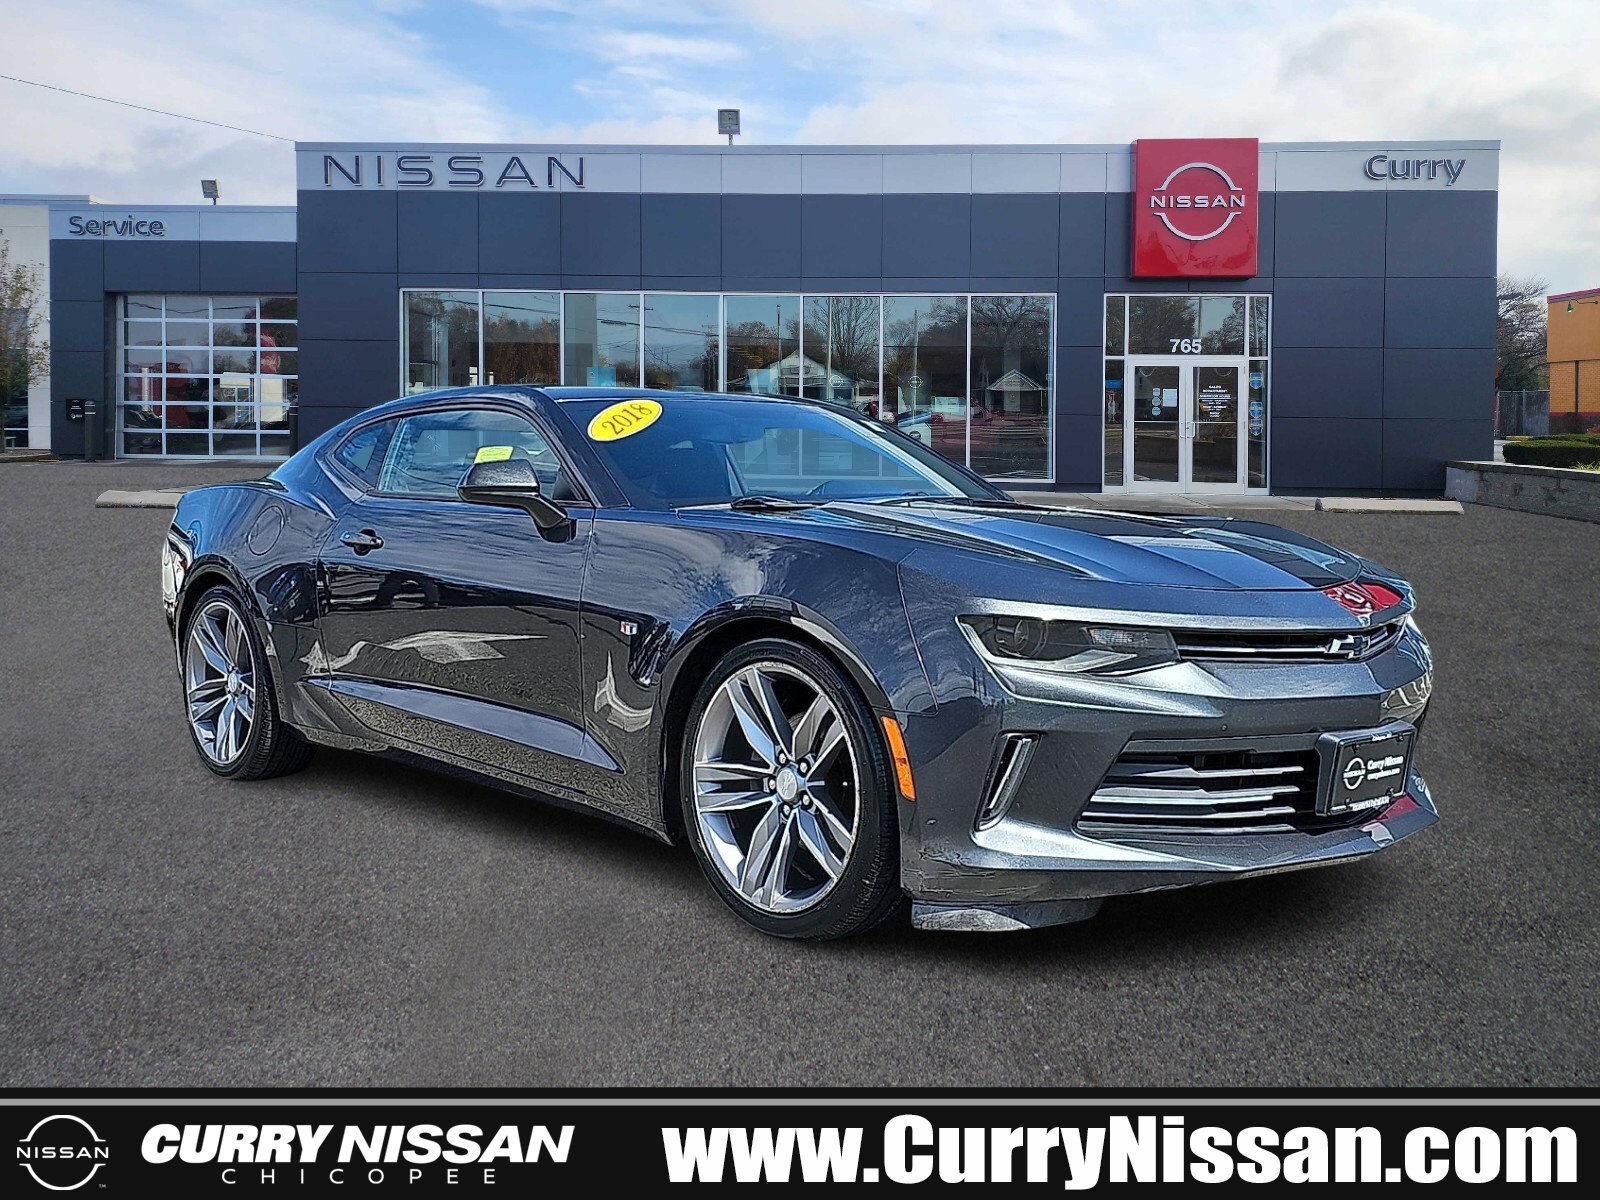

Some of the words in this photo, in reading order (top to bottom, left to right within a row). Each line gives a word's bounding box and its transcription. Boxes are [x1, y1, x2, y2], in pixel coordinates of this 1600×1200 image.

[323, 155, 585, 188] NISSAN
[1364, 154, 1466, 186] Curry
[1150, 194, 1245, 208] NISSAN
[69, 214, 165, 236] Service
[1169, 338, 1202, 354] 765
[602, 403, 653, 435] 2018
